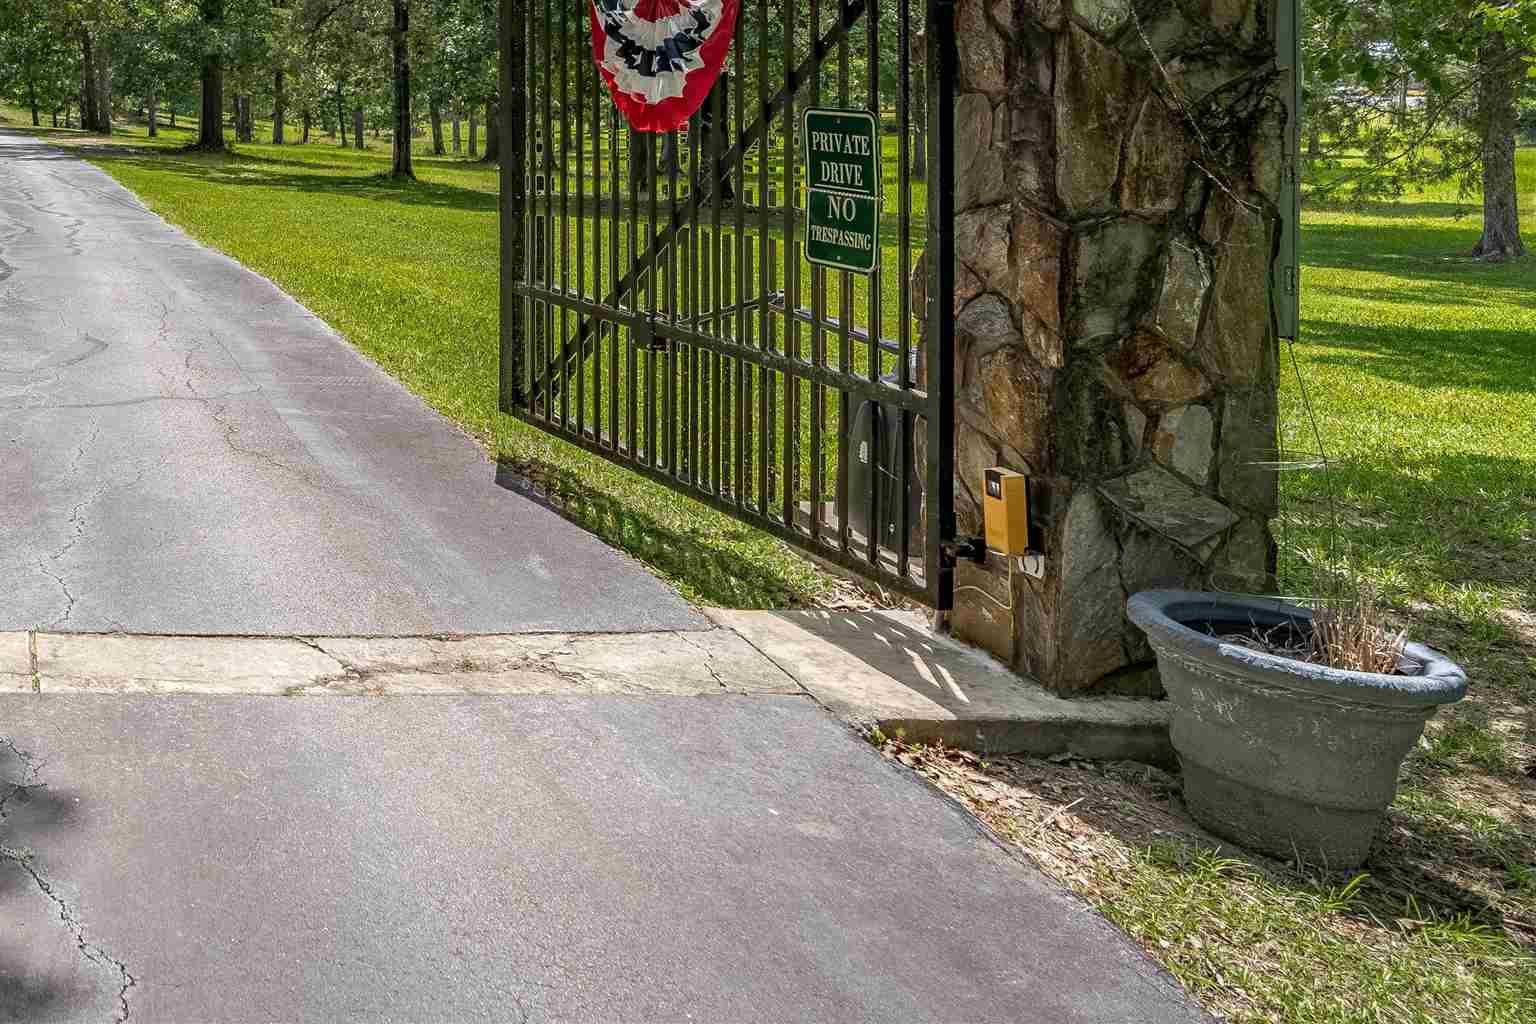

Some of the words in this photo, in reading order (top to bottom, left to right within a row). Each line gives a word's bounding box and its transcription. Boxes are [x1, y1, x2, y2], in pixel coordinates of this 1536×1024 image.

[811, 131, 870, 155] PRIVATE
[821, 161, 863, 186] DRIVE
[827, 195, 856, 222] NO
[810, 225, 871, 250] TRESPASSING
